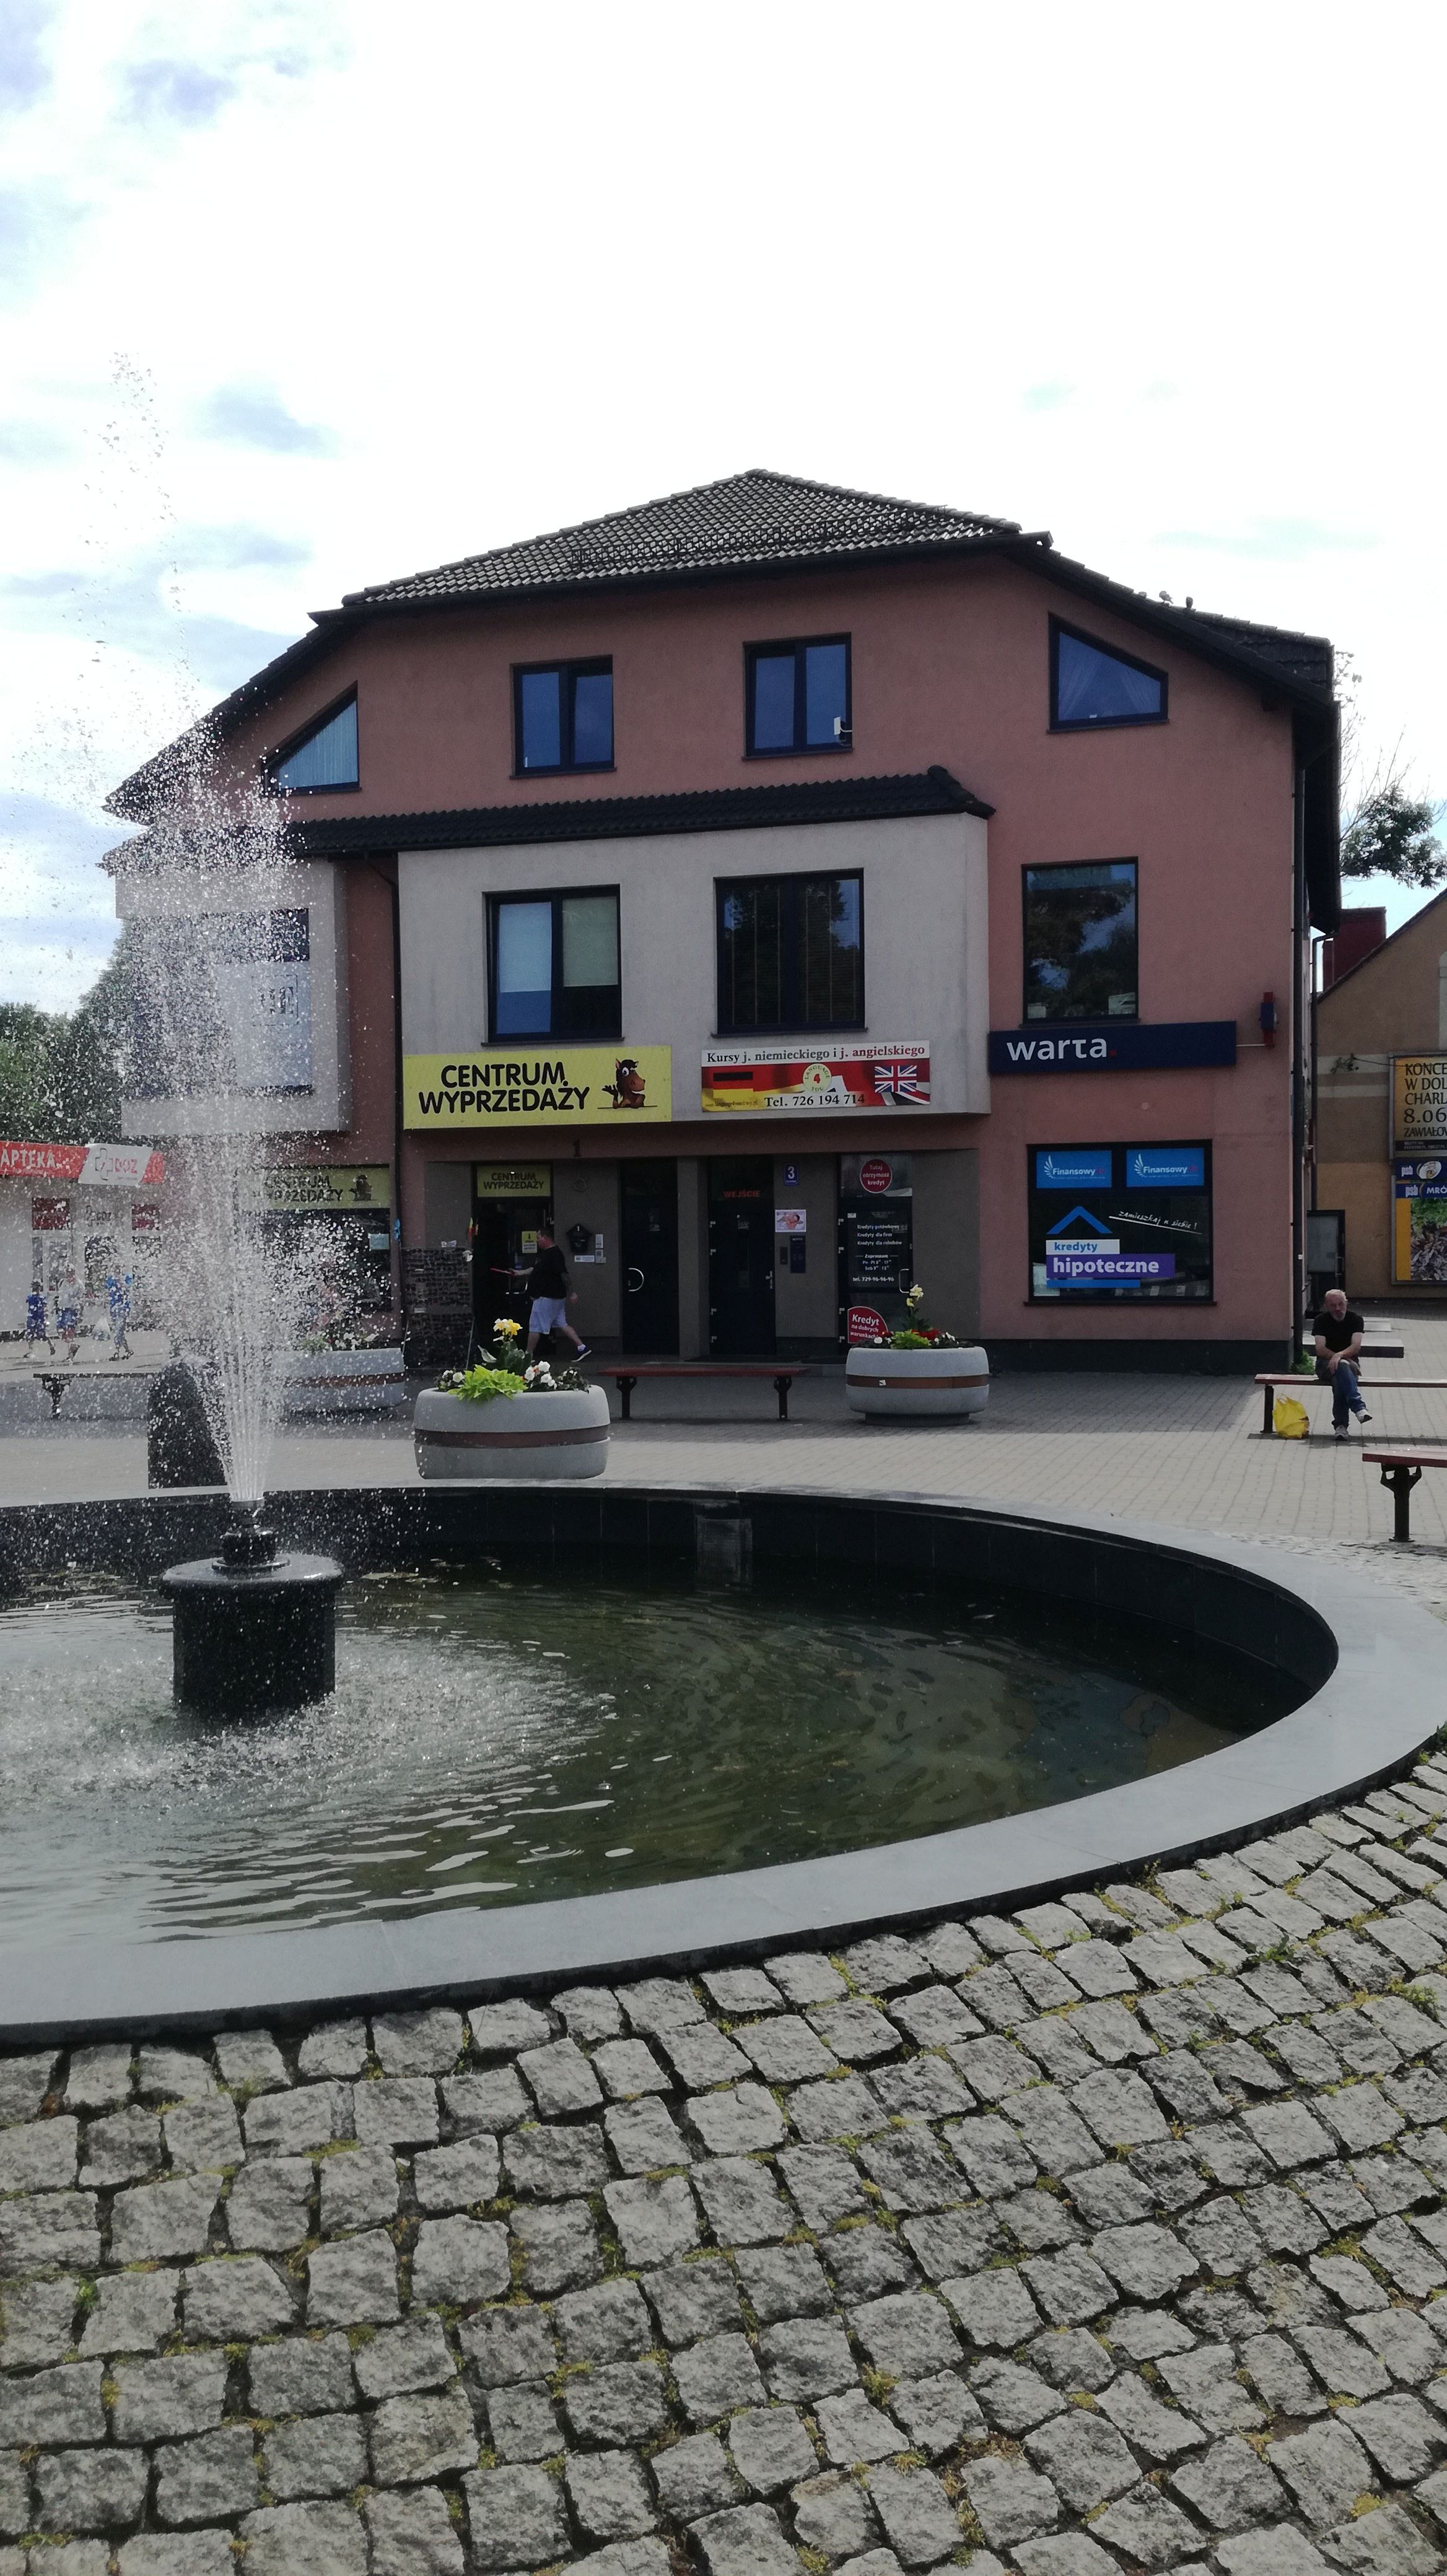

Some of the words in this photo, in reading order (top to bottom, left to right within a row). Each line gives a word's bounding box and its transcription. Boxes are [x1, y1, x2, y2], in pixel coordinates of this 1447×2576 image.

[707, 1052, 740, 1064] Kursy
[742, 1051, 751, 1064] j.
[754, 1048, 829, 1061] niemieckiego
[833, 1048, 837, 1058] i
[839, 1047, 849, 1060] j.
[852, 1045, 925, 1058] angielskiego
[440, 1061, 566, 1088] CENTRUM
[813, 1073, 821, 1084] 4
[1404, 1078, 1418, 1090] W
[419, 1080, 590, 1114] WYPRZEDAŻY
[764, 1097, 788, 1107] Tel.
[792, 1095, 814, 1107] 726
[819, 1095, 839, 1105] 194
[844, 1094, 865, 1104] 714
[1, 1148, 56, 1168] APTEKA
[115, 1157, 138, 1174] DOZ
[1052, 1167, 1096, 1176] Finansowy
[1143, 1166, 1188, 1174] Finansowy
[491, 1172, 536, 1181] CENTRUM
[787, 1165, 795, 1179] 3
[483, 1179, 544, 1190] WYPRZEDAŻY
[724, 1189, 762, 1198] WEJŚCIE
[1054, 1242, 1098, 1253] kredyty
[1053, 1257, 1160, 1277] hipoteczne
[852, 1313, 880, 1326] Kredyt
[858, 1324, 879, 1333] dobrych
